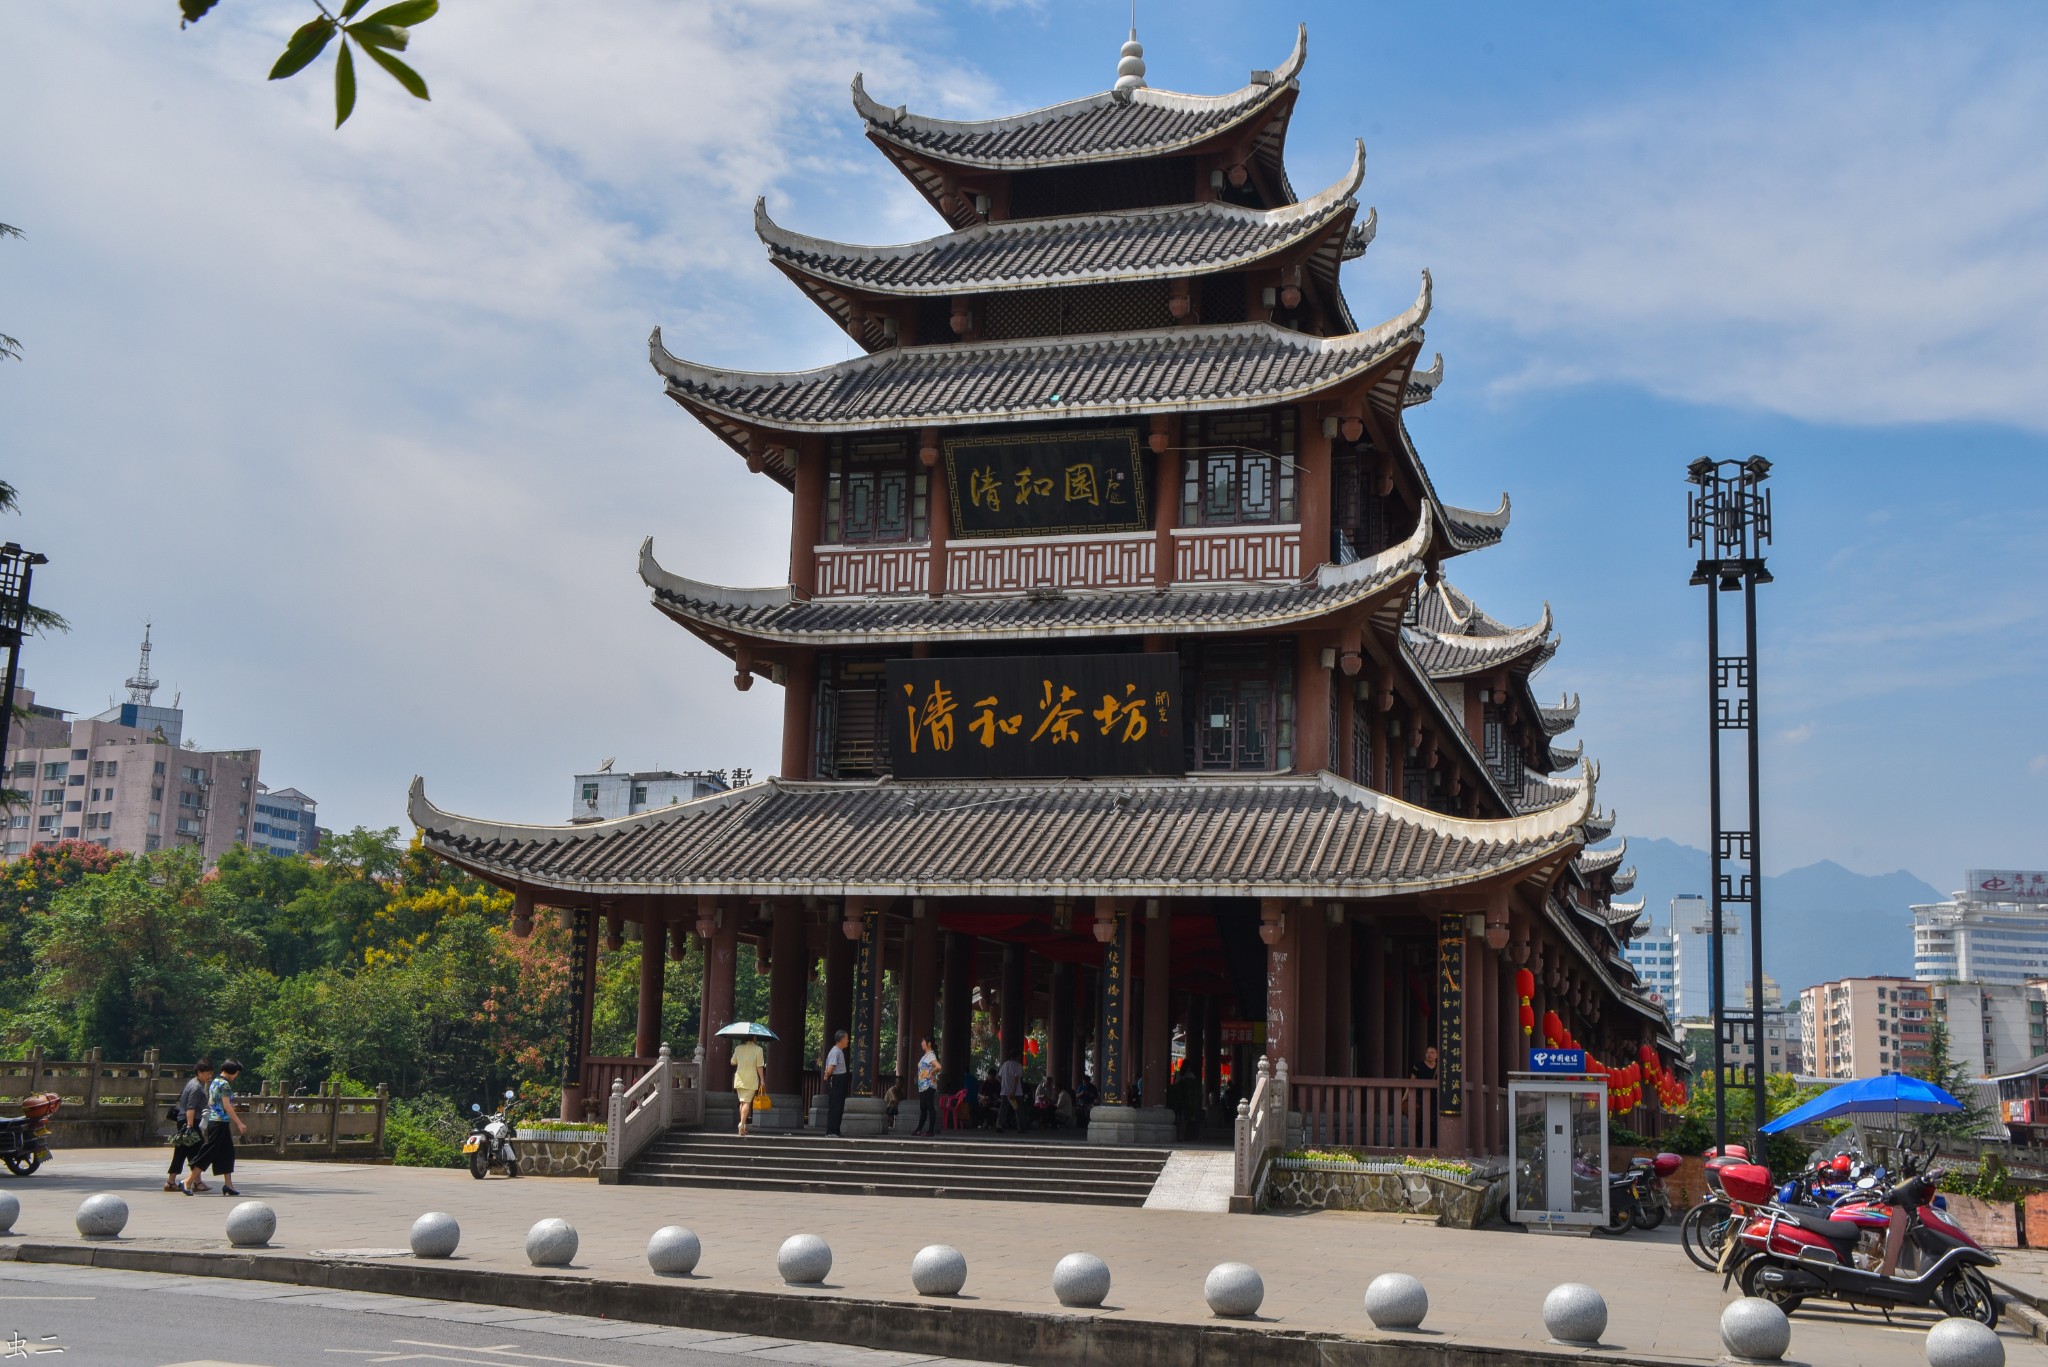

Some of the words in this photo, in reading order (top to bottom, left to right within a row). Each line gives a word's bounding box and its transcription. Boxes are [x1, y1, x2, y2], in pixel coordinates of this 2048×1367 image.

[903, 680, 1148, 753] 清和茶坊
[1549, 1053, 1578, 1063] 中国电信
